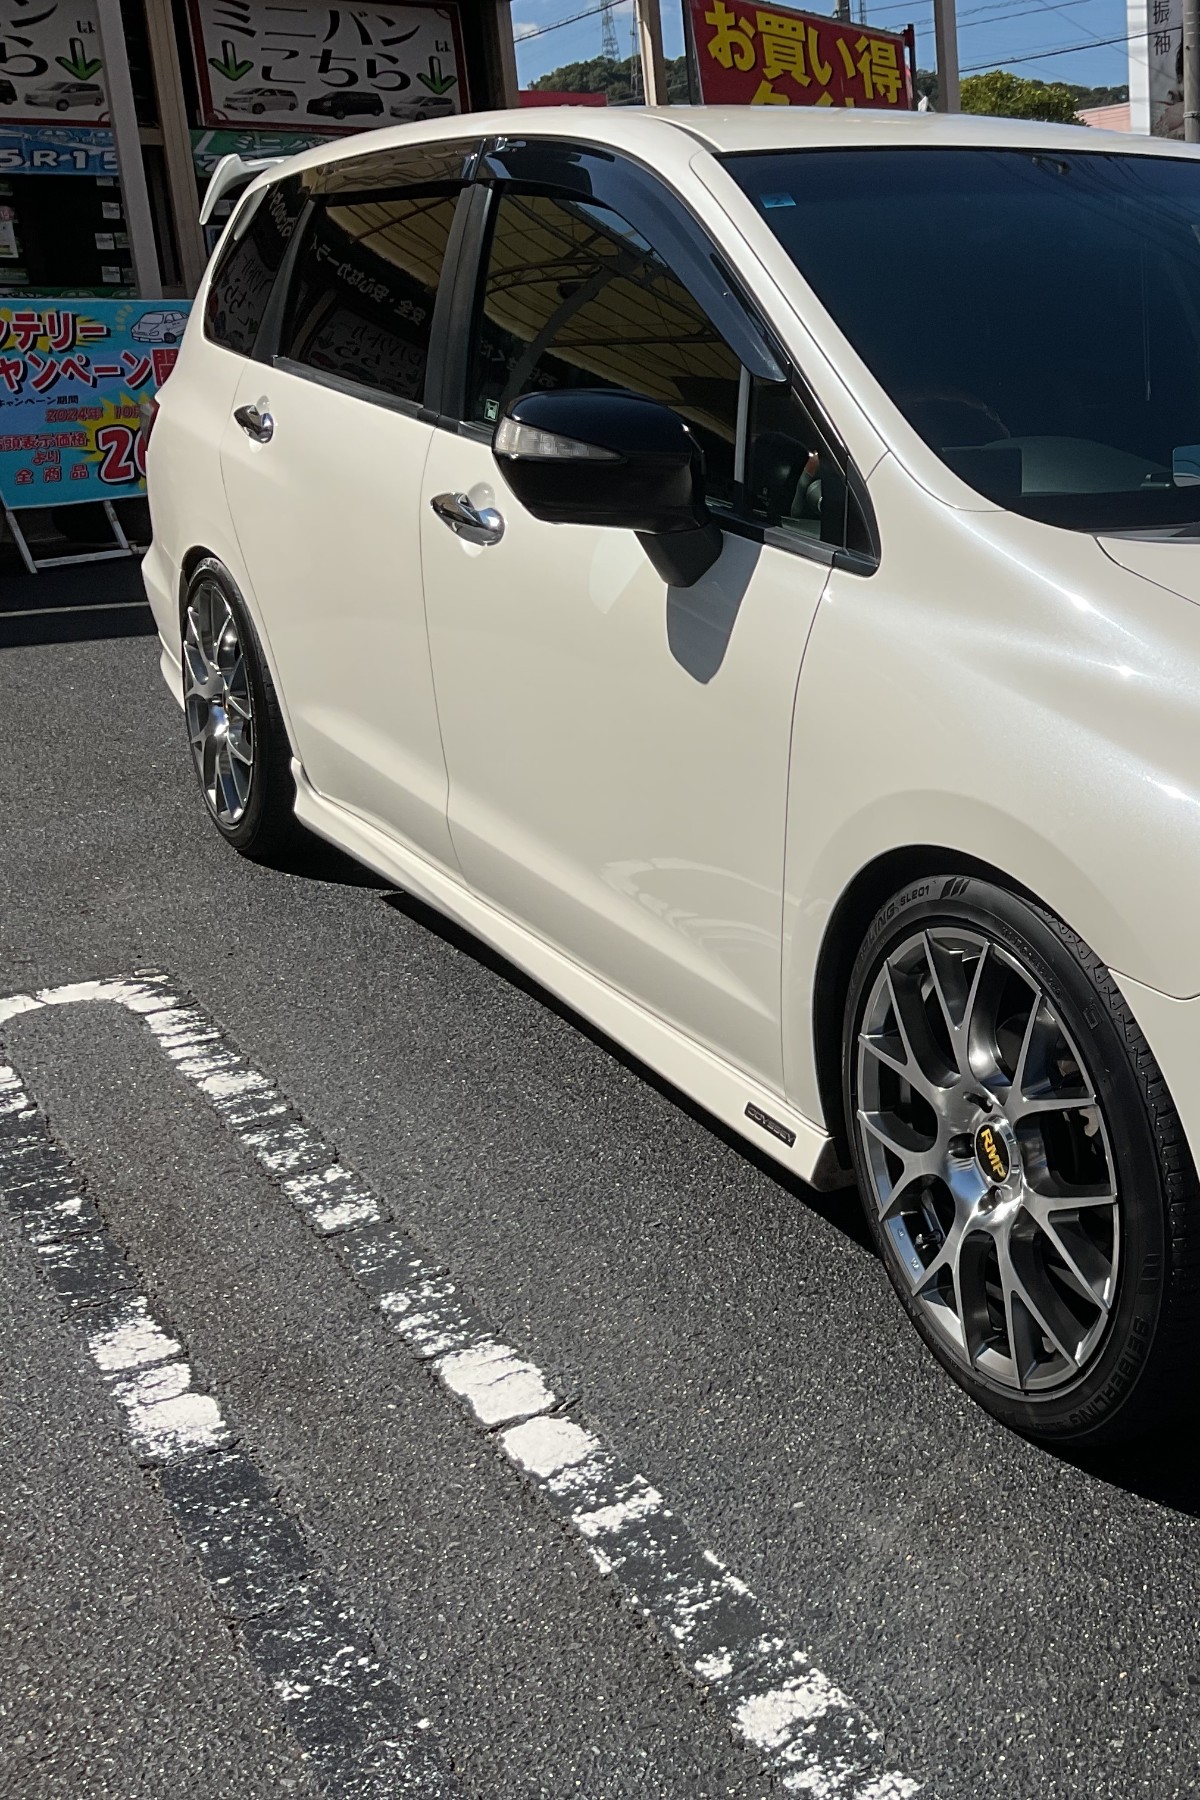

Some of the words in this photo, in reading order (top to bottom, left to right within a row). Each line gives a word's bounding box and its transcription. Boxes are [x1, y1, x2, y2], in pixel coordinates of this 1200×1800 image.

[212, 0, 421, 47] ミニバン
[260, 48, 411, 91] こちら
[704, 0, 902, 104] お買い得
[46, 405, 104, 423] 2024年
[32, 450, 60, 466] より
[980, 1128, 1006, 1177] RMP
